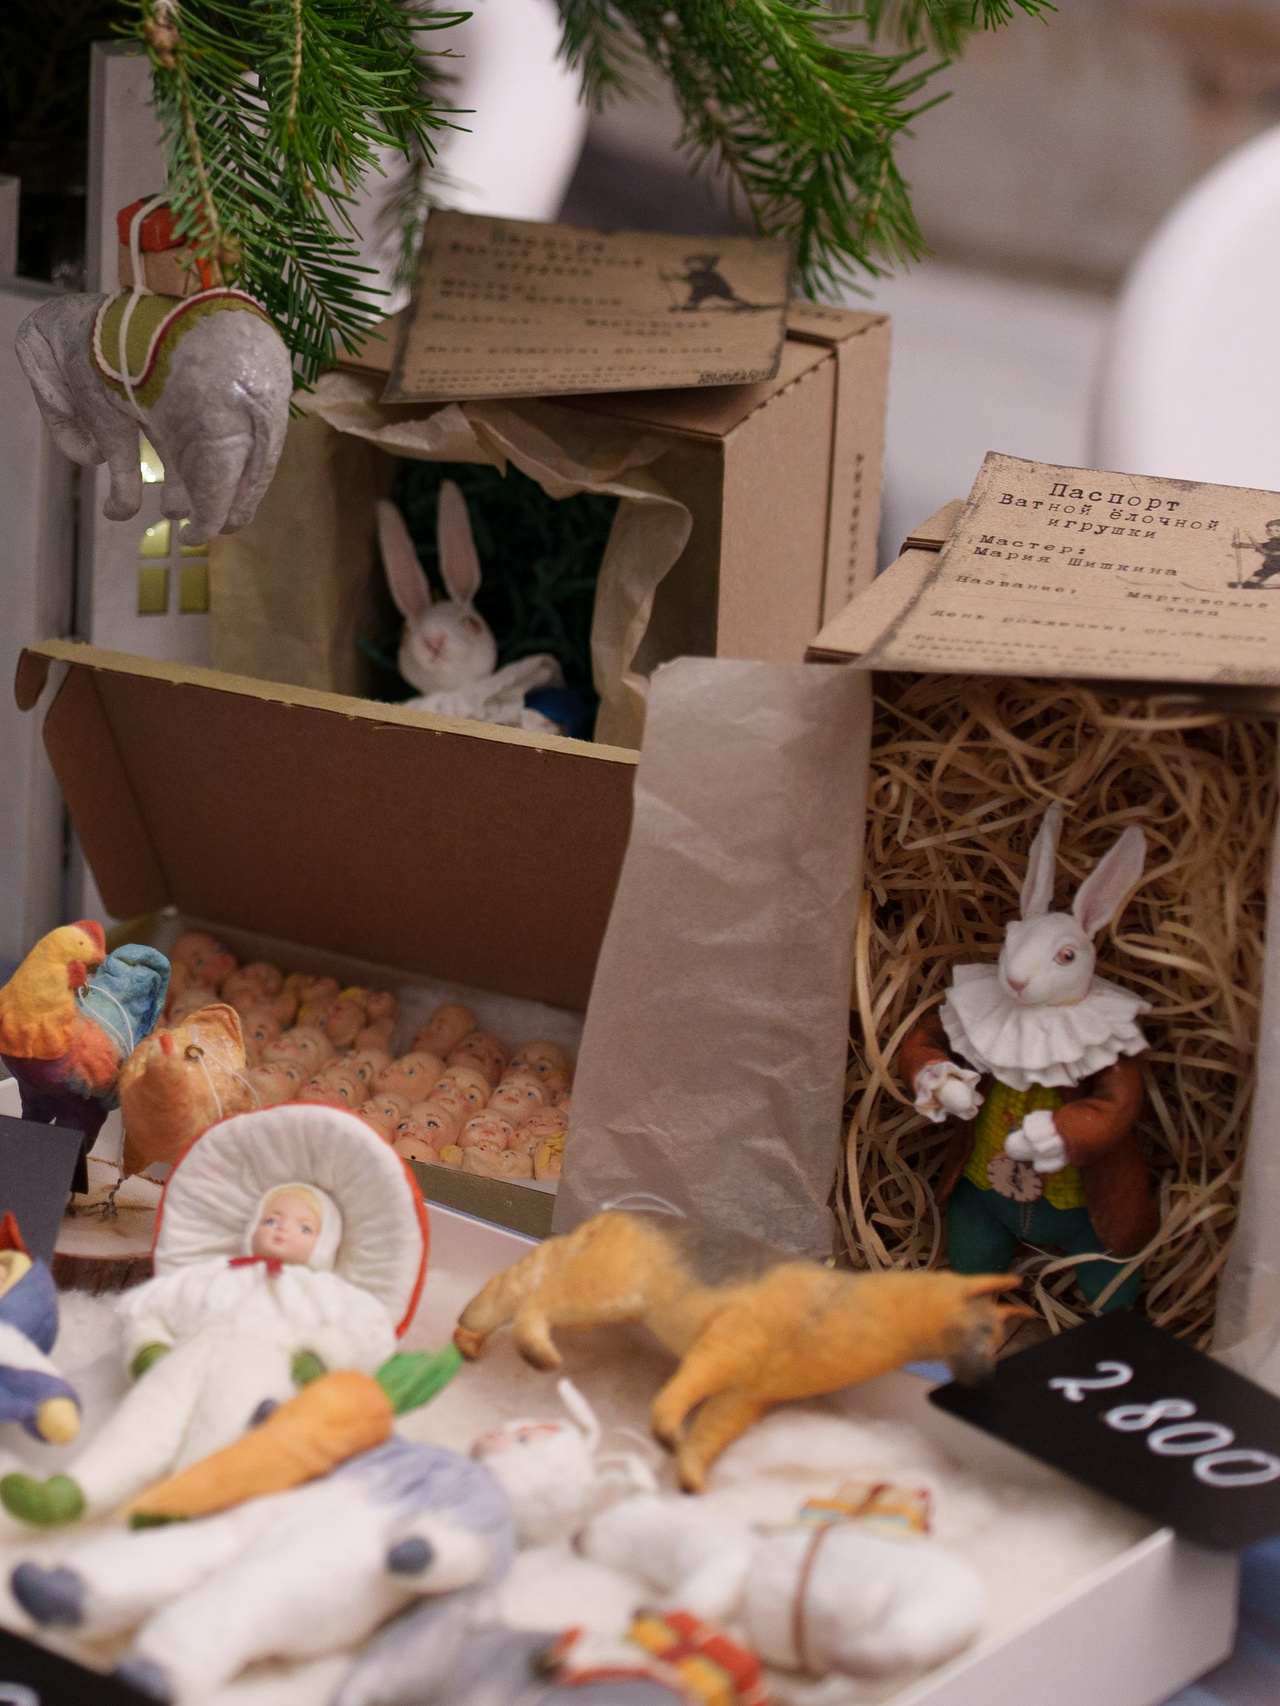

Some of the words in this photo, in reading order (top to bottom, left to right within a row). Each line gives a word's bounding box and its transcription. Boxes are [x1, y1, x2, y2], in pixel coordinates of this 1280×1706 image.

[1048, 482, 1181, 512] Паспорт
[998, 492, 1093, 516] Ватной
[1109, 508, 1220, 532] ёлочной
[1046, 517, 1158, 540] игрушки
[979, 533, 1087, 556] Мастер:
[972, 545, 1052, 565] Мария
[1067, 556, 1179, 577] Шишкина
[955, 574, 1077, 595] Название:
